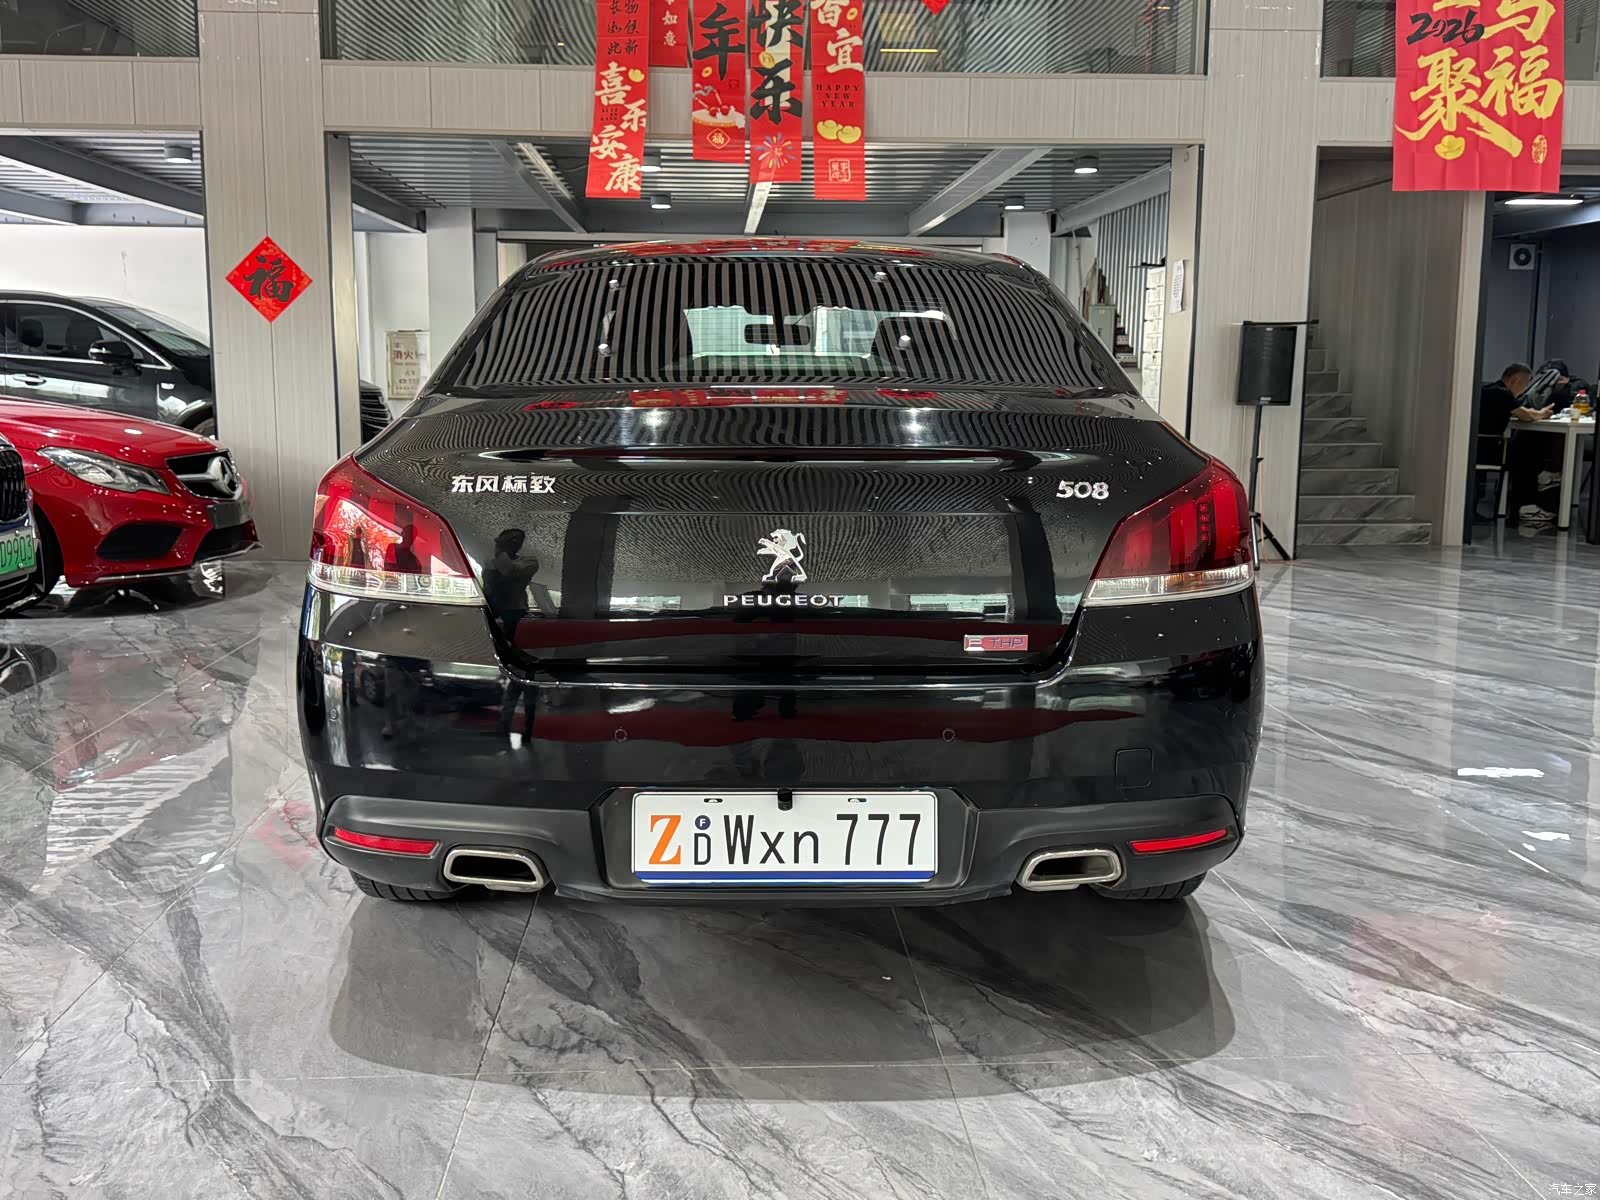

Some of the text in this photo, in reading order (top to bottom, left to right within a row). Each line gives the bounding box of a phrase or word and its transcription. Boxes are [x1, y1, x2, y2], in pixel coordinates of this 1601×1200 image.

[693, 6, 746, 80] 年
[1406, 9, 1485, 47] 2026
[749, 0, 803, 125] 快乐
[1394, 46, 1564, 158] 聚福
[243, 255, 294, 302] 福
[451, 474, 556, 494] 东风标致
[1055, 480, 1110, 500] 508
[723, 594, 844, 607] PEUGEOT
[990, 638, 1025, 649] THP
[648, 813, 922, 866] Z D Wxn 777
